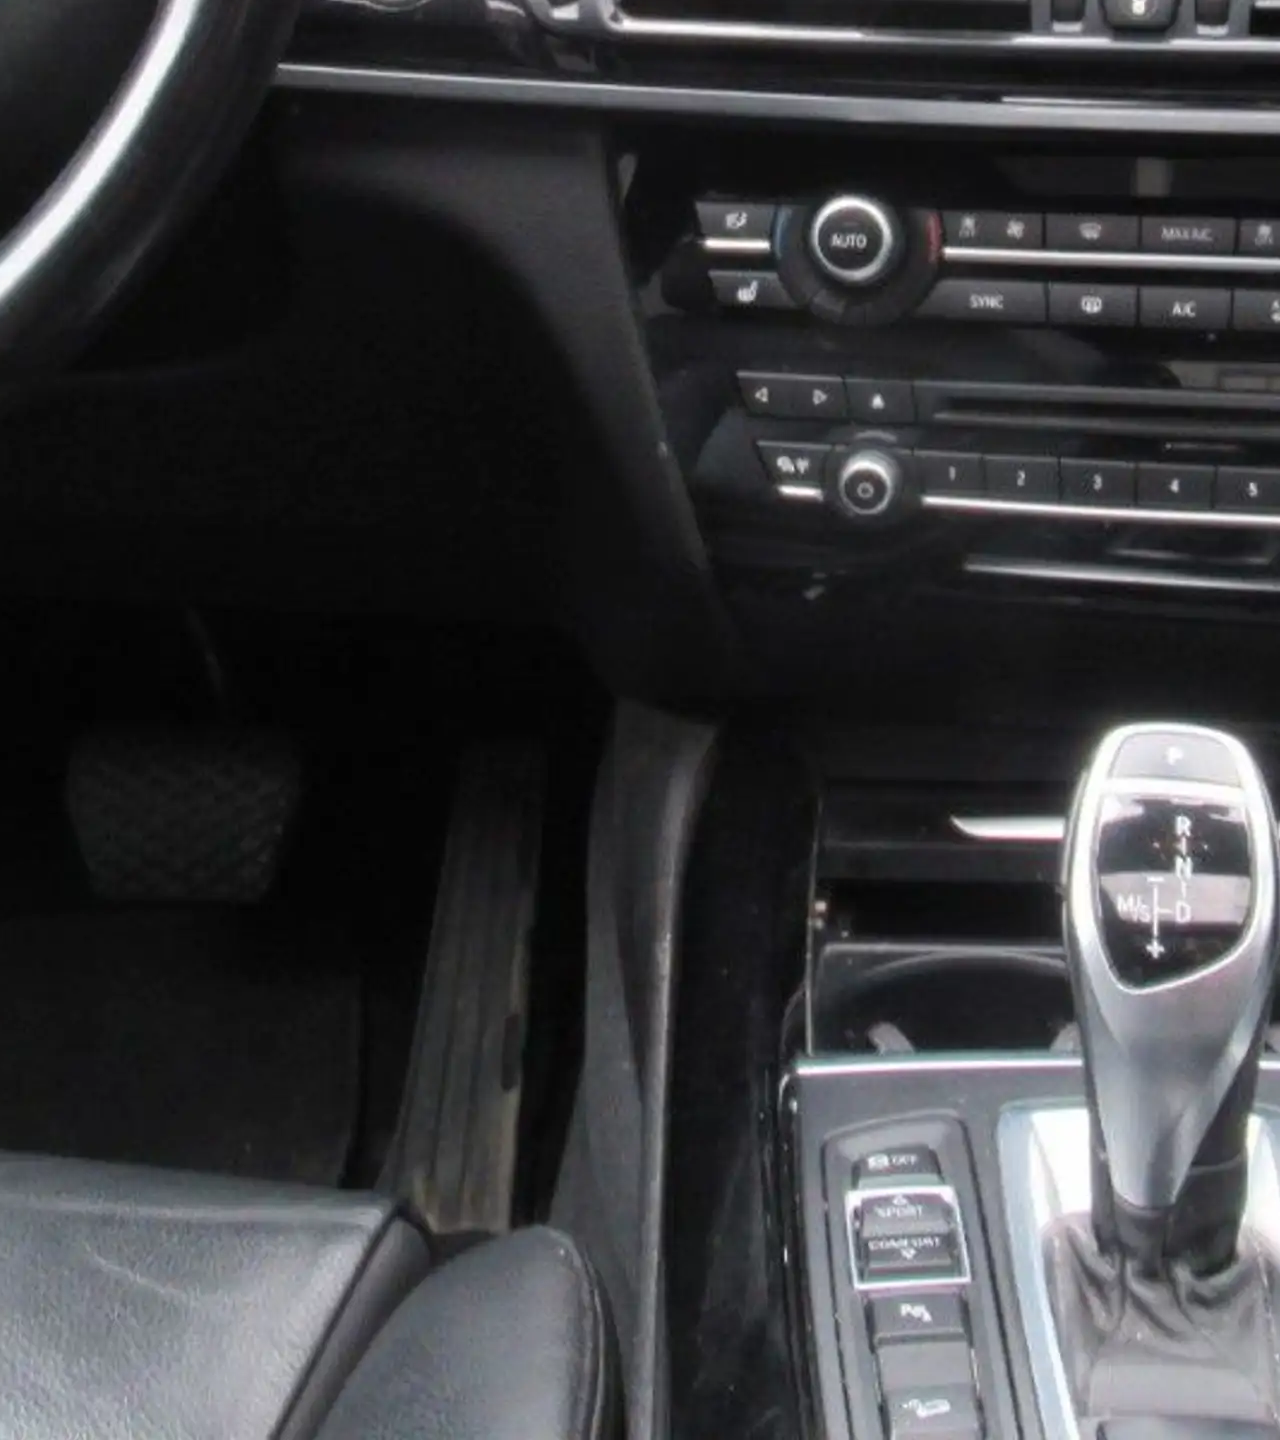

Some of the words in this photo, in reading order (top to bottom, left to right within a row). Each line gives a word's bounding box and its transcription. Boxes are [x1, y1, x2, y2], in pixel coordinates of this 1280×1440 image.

[831, 232, 868, 250] AUTO
[970, 293, 1004, 309] SYNC
[1172, 300, 1197, 318] A/C
[1016, 469, 1026, 487] 2
[1092, 473, 1103, 492] 3
[1169, 477, 1180, 494] 4
[1175, 815, 1192, 838] R
[1175, 856, 1193, 880] N
[1175, 901, 1192, 923] D
[875, 1204, 923, 1218] SPORT
